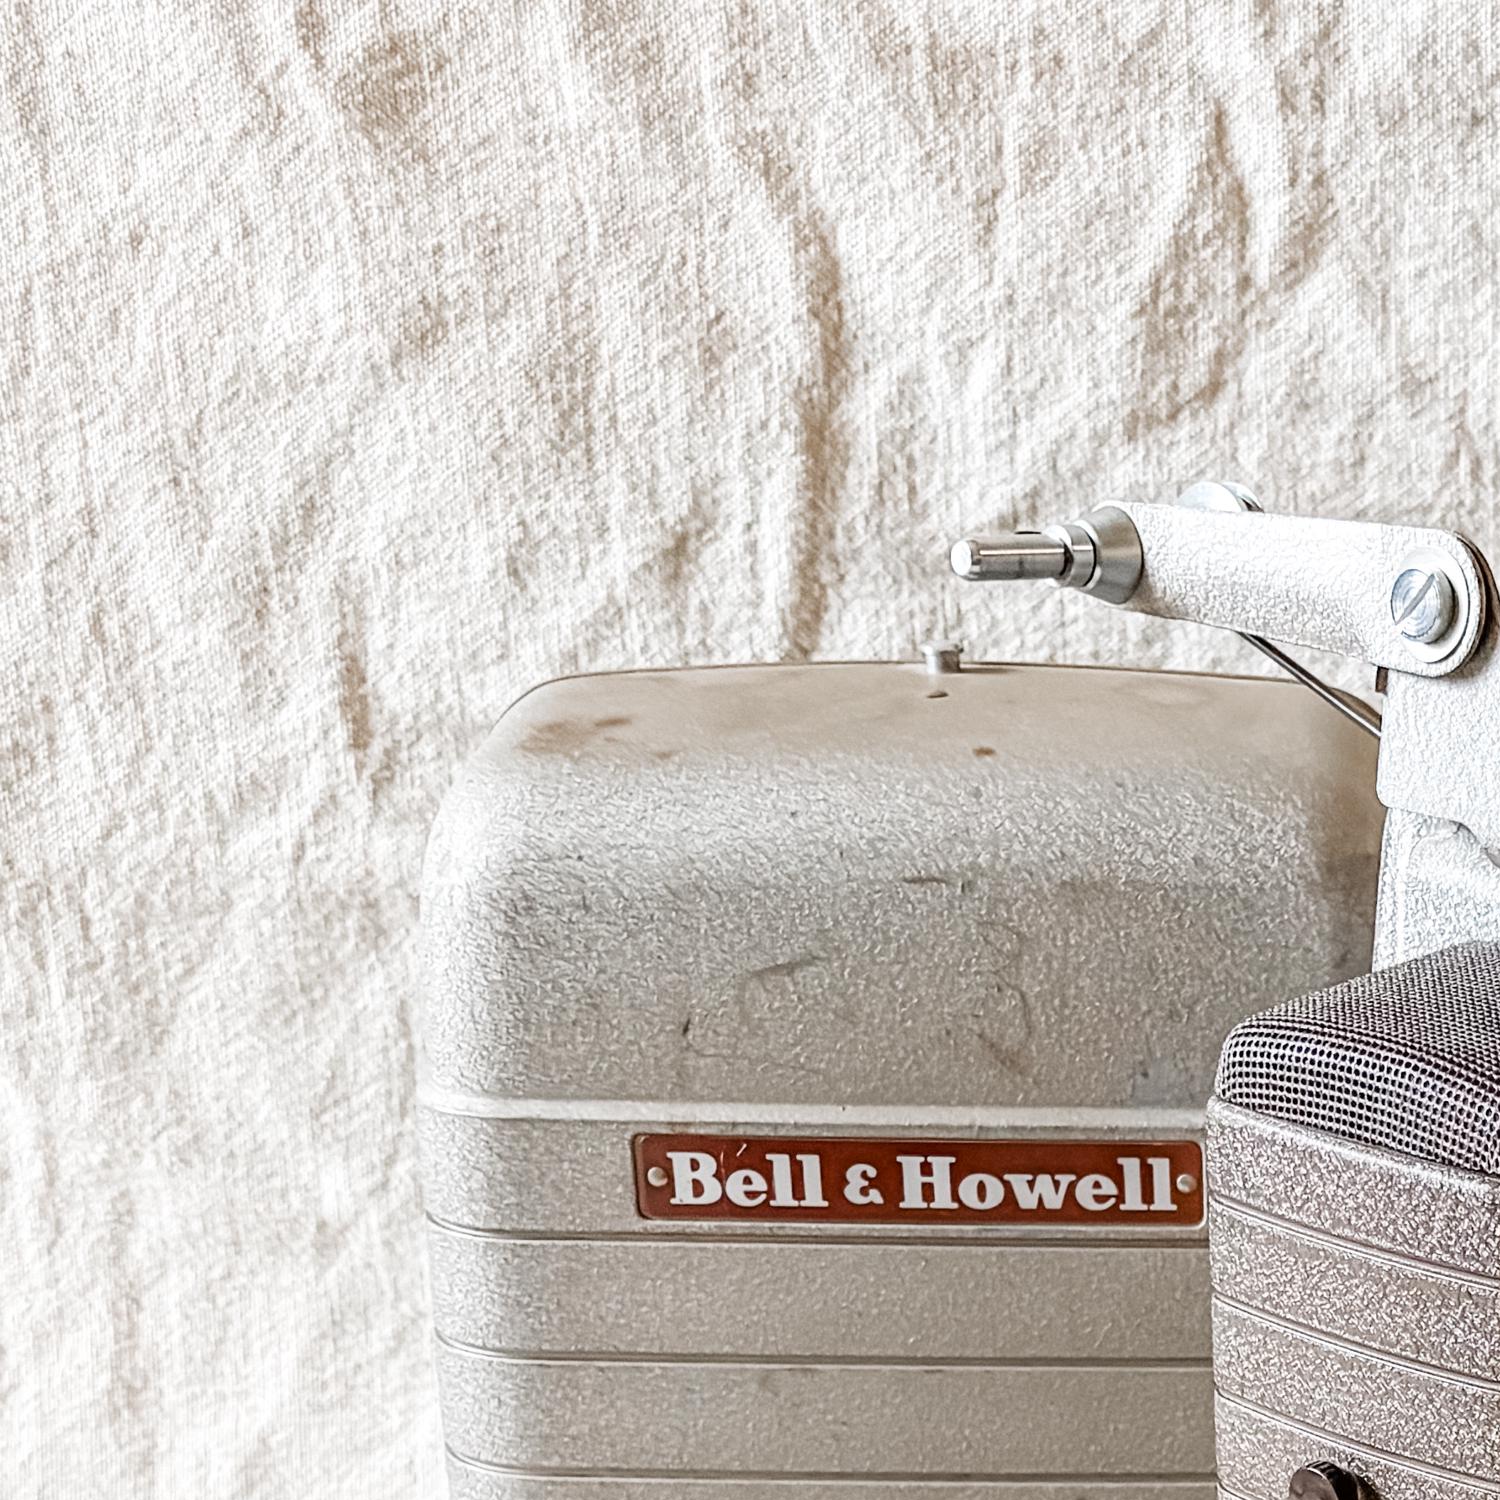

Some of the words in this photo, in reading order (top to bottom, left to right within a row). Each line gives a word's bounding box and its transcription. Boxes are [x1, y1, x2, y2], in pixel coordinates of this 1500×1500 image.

[667, 1151, 829, 1208] Bell
[843, 1163, 884, 1205] &
[896, 1155, 1178, 1212] Howell
